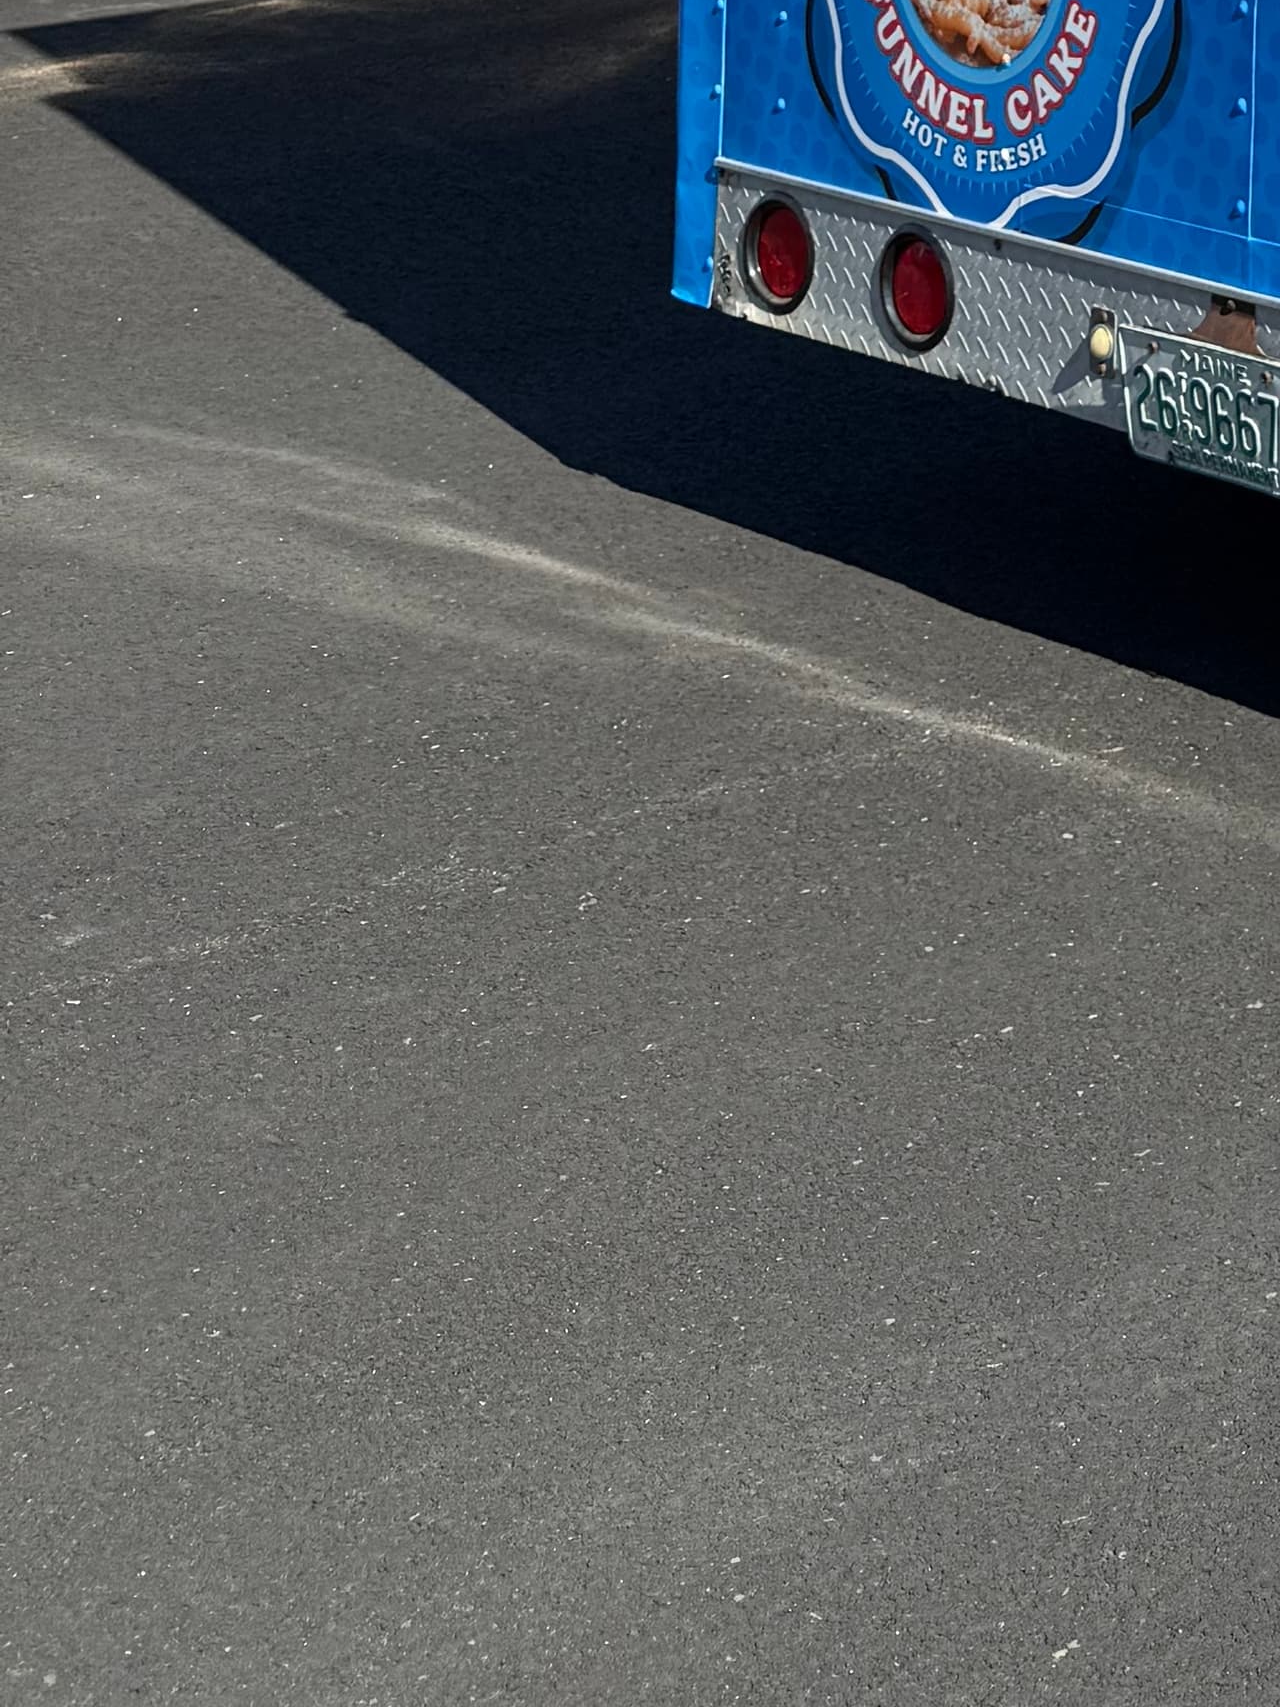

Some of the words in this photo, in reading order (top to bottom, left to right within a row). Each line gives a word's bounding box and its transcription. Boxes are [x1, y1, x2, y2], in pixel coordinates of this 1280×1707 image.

[902, 107, 948, 158] HOT
[952, 148, 968, 169] &
[975, 132, 1047, 173] FRESH
[1180, 348, 1252, 387] MAINE
